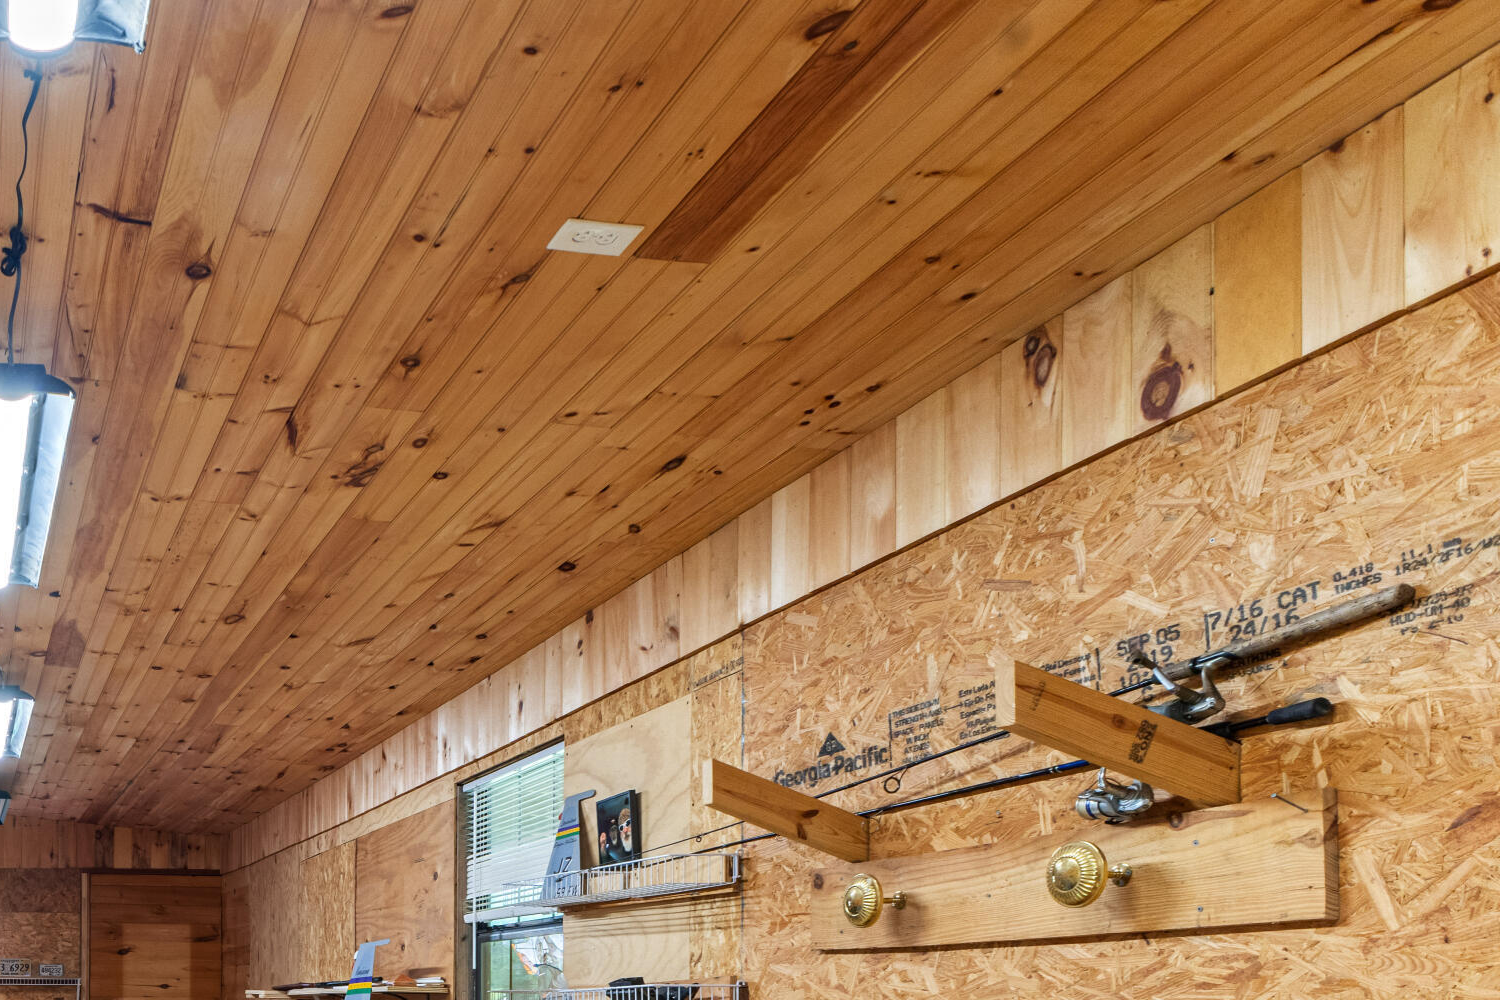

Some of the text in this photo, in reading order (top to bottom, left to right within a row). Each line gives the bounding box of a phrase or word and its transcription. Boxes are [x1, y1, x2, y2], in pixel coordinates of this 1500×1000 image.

[1333, 562, 1374, 583] 0.418
[1208, 580, 1321, 631] 7/16 CAT
[1229, 606, 1300, 640] 24/16
[1116, 624, 1181, 658] SEP 05
[9, 963, 30, 972] 6929
